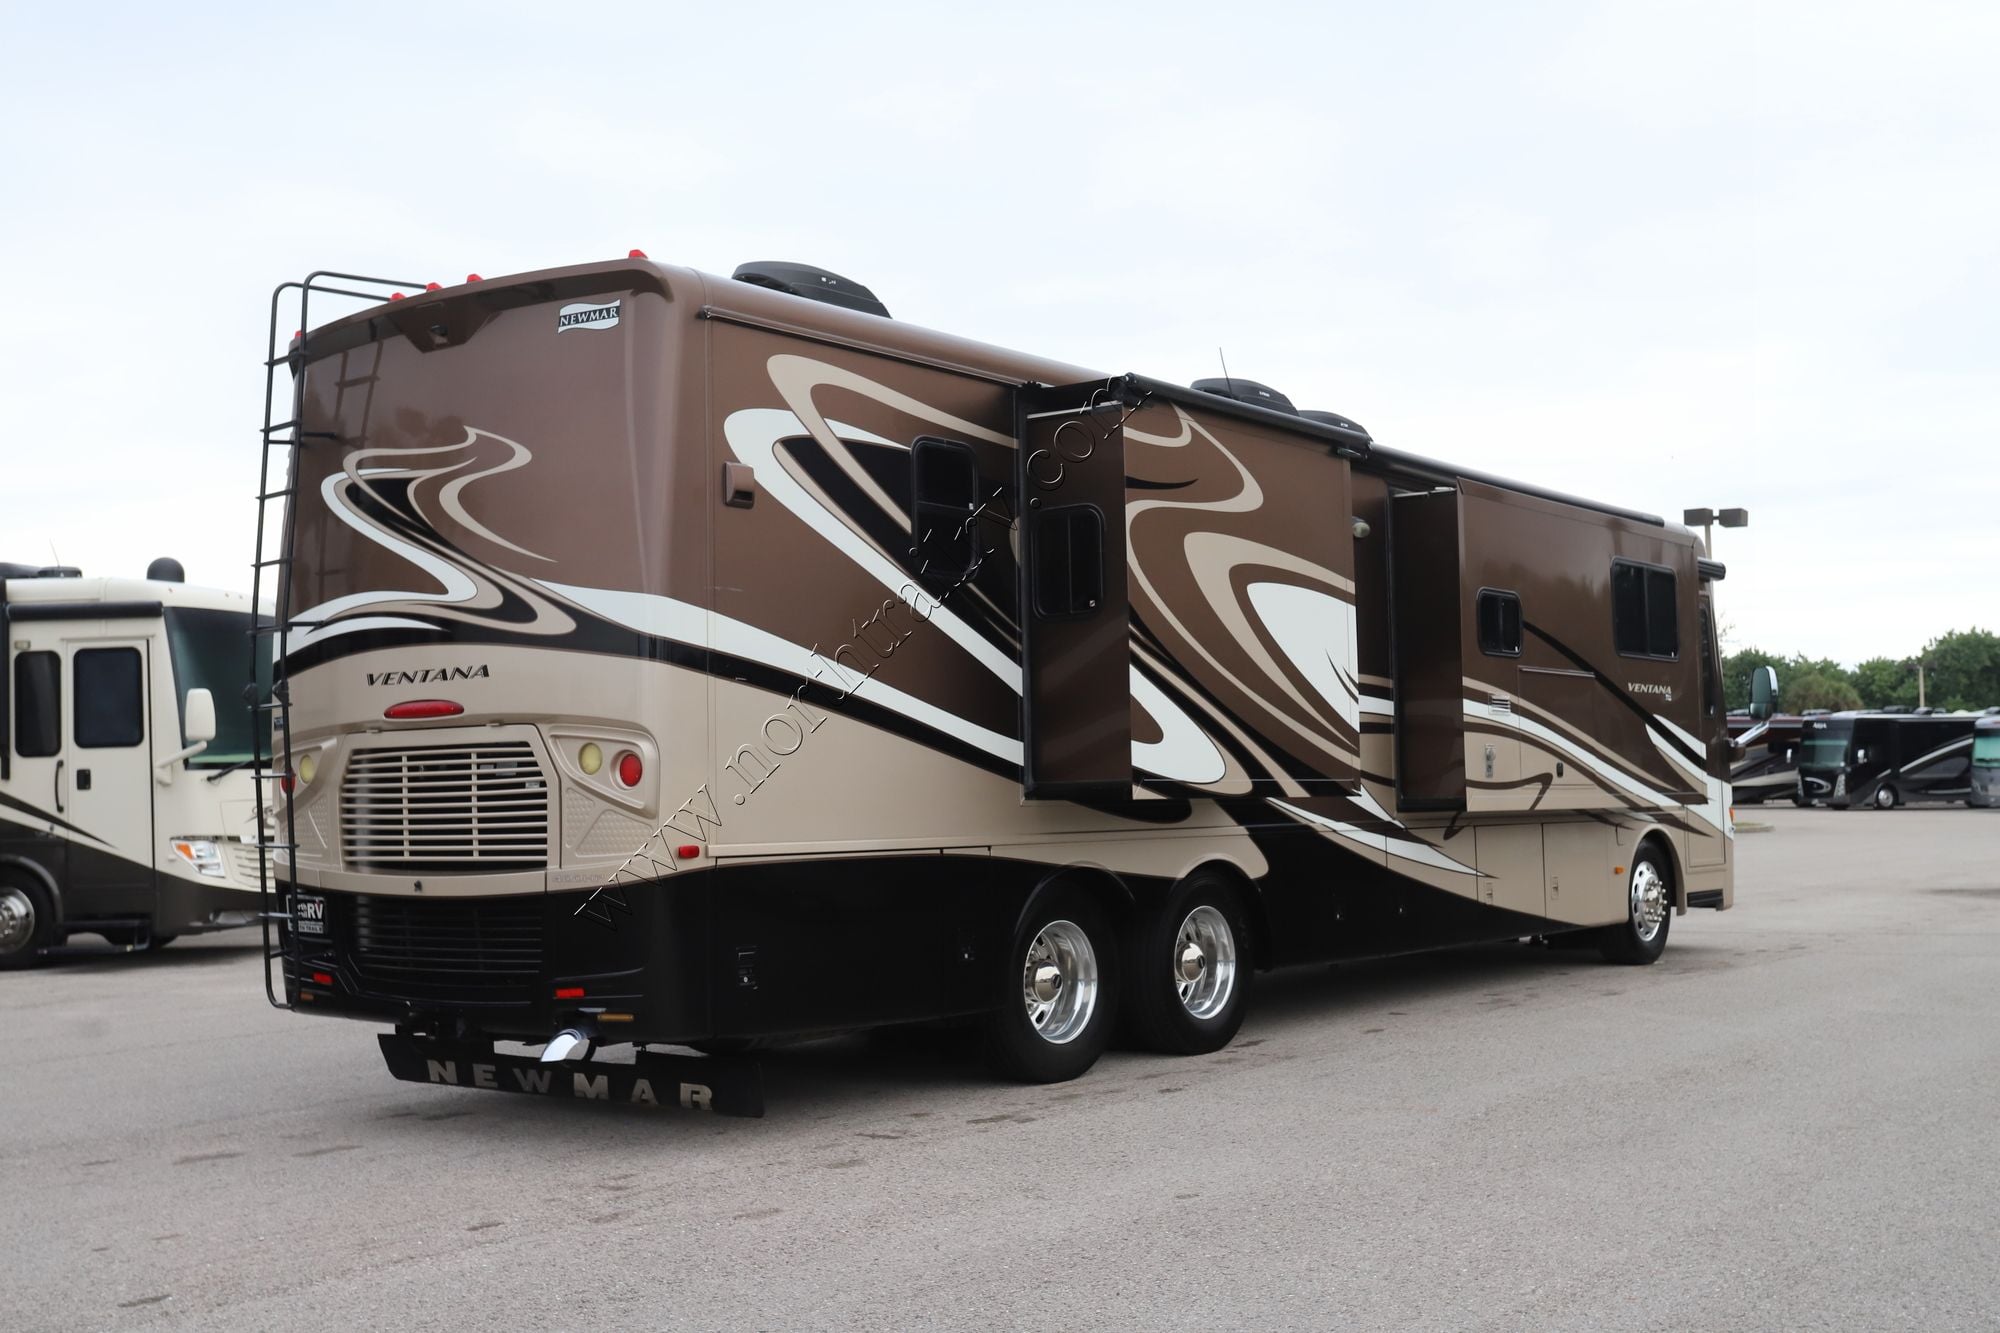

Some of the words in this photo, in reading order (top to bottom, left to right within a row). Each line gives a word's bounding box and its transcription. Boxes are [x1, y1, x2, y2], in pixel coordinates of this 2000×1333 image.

[560, 307, 618, 327] NEWMAR
[366, 664, 490, 687] VENTANA
[1627, 682, 1672, 695] VENTANA
[307, 902, 324, 919] RV
[427, 1059, 713, 1111] NEWMAR
